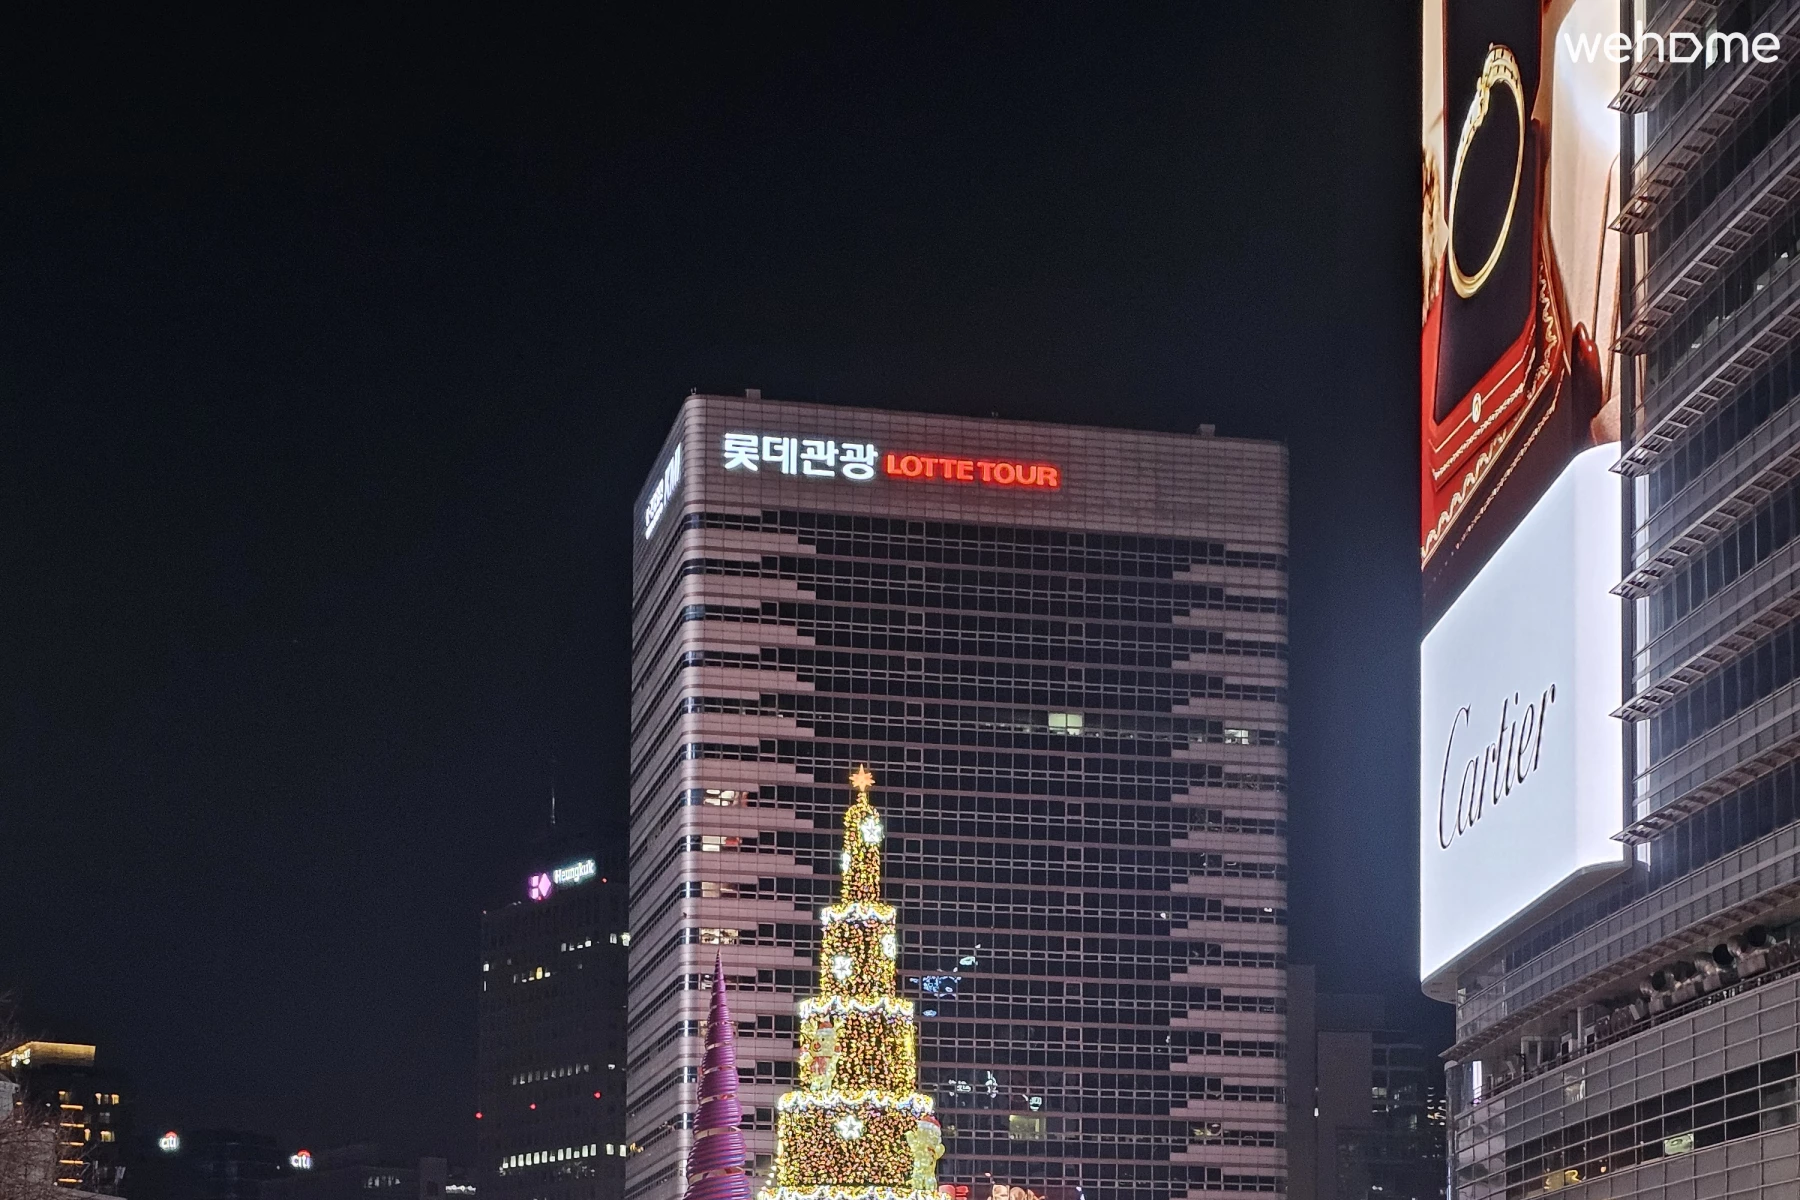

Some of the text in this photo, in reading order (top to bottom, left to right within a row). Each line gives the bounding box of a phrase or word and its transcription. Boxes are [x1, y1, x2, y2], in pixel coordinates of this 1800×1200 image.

[724, 433, 1057, 487] 롯데관광 LOTTE TOUR
[1439, 683, 1556, 850] Cartier
[554, 860, 596, 884] Heungkuk
[291, 1151, 311, 1169] citi
